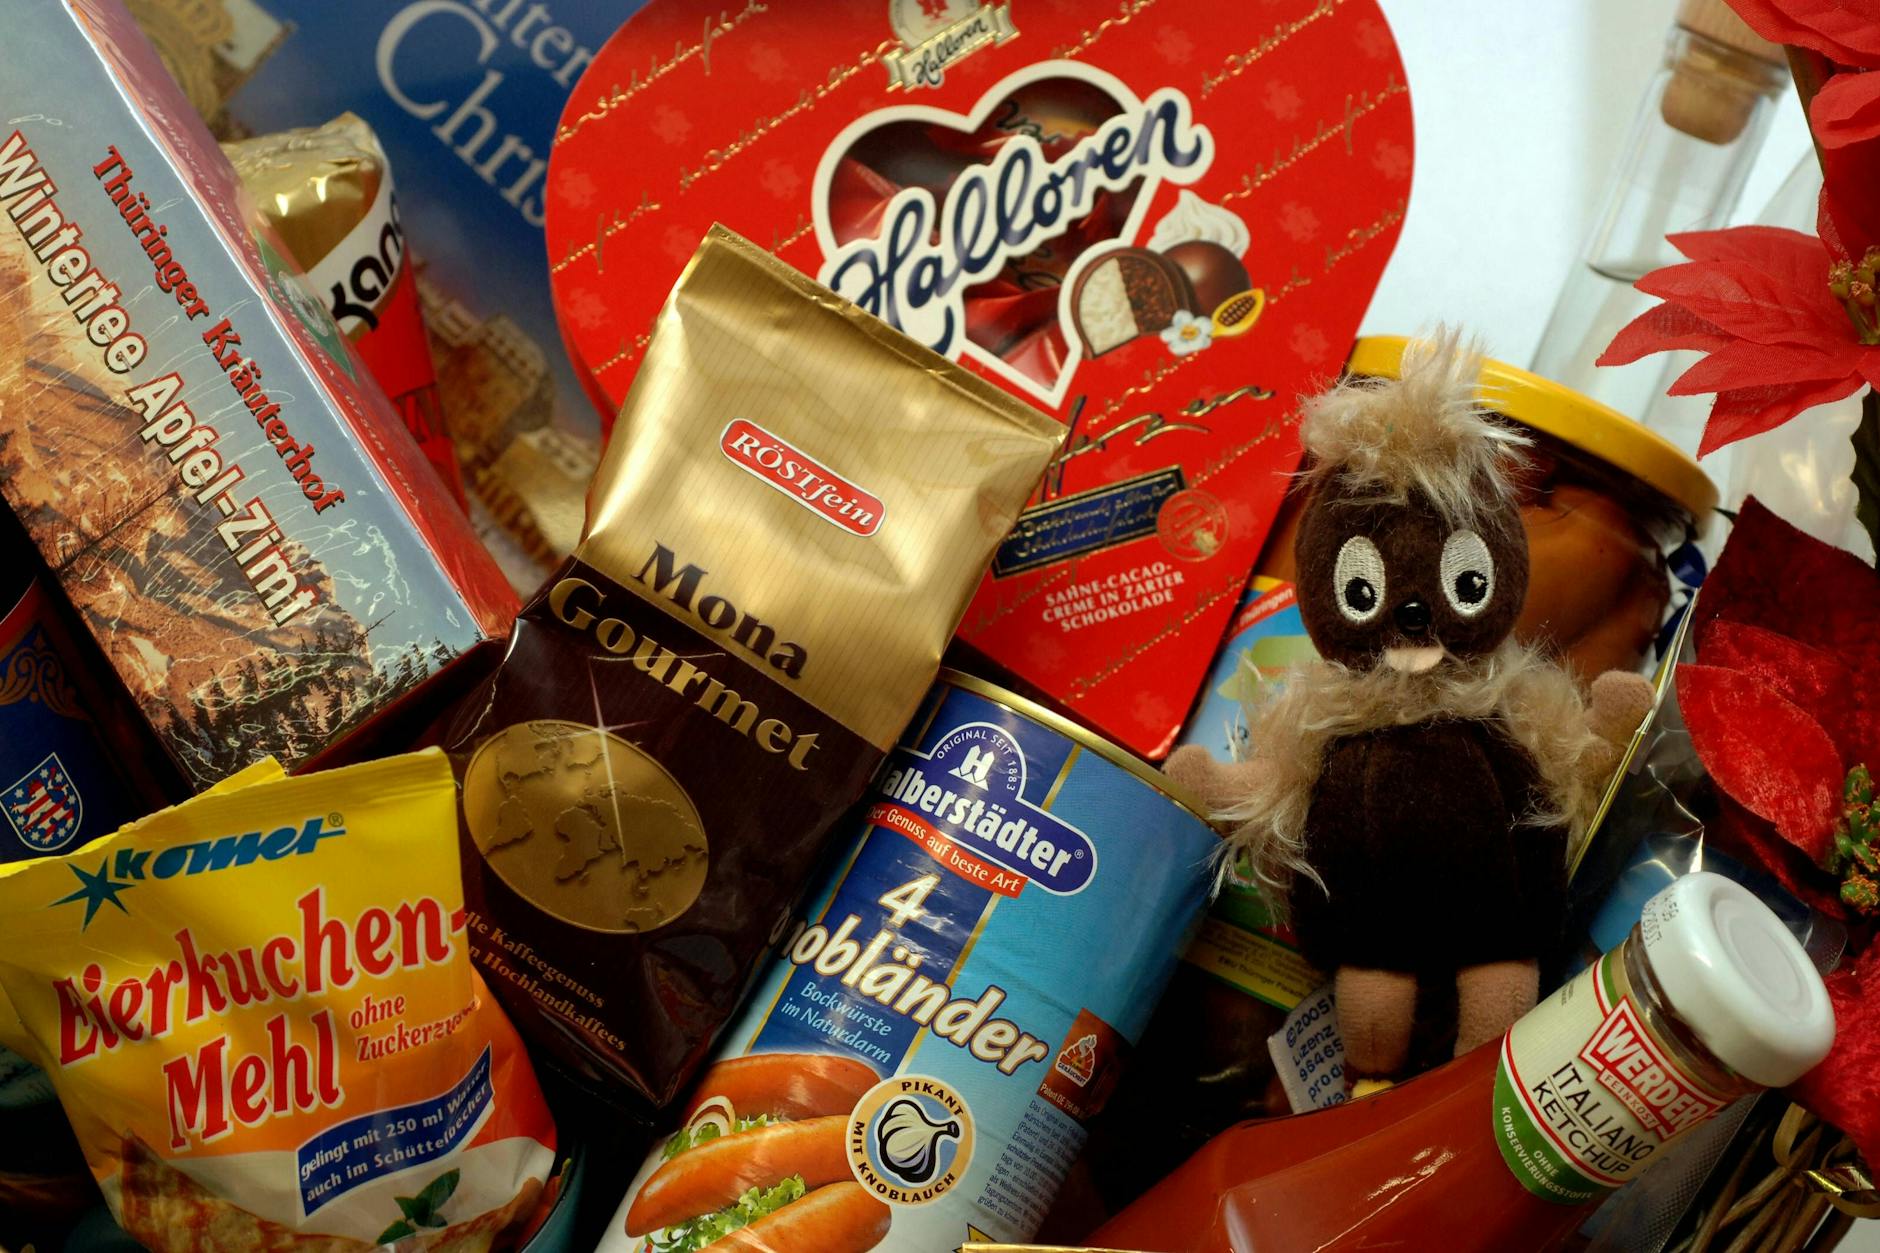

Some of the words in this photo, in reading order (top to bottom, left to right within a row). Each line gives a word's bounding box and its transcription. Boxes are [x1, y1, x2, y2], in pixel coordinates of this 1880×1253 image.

[911, 18, 988, 86] Halloren
[830, 98, 1204, 354] Halloren
[92, 146, 210, 321] Thüringer
[201, 317, 346, 516] Kräuterhof
[0, 130, 148, 375] Wintertee
[124, 371, 319, 627] Apfel-Zimt
[727, 431, 877, 529] RÖSTfein
[632, 541, 809, 681] Mona
[1042, 597, 1097, 623] CREME
[1100, 588, 1121, 606] IN
[1124, 571, 1185, 600] ZARTER
[1060, 588, 1175, 632] SCHOKOLADE
[548, 577, 822, 772] Gourmet
[937, 729, 988, 760] ORIGINAL
[990, 734, 1014, 758] SEIT
[1006, 759, 1018, 792] 1883
[882, 766, 1073, 878] alberstädter
[887, 808, 928, 840] Genuss
[926, 834, 950, 858] auf
[950, 849, 989, 882] beste
[989, 870, 1021, 892] Art
[878, 873, 941, 928] 4
[53, 887, 467, 1067] Eierkuchen-
[480, 951, 628, 1051] Hochlandkaffees
[494, 928, 605, 1009] Kaffeegenuss
[800, 981, 893, 1037] Bockwürste
[781, 996, 801, 1019] im
[801, 1005, 892, 1066] Naturdarm
[1292, 1024, 1336, 1067] Lizenz
[162, 1010, 345, 1152] Mehl
[351, 996, 406, 1029] ohne
[901, 1079, 965, 1117] PIKANT
[1552, 1062, 1656, 1161] ITALIANO
[1597, 1017, 1708, 1128] WERDER
[1603, 1074, 1655, 1127] FEINKOST
[301, 1139, 350, 1182] gelingt
[353, 1126, 381, 1150] mit
[385, 1117, 417, 1138] 250
[422, 1107, 444, 1129] ml
[307, 1173, 342, 1202] auch
[346, 1162, 369, 1179] im
[374, 1083, 488, 1168] Schüttelbecher
[852, 1120, 865, 1157] MIT
[1532, 1080, 1630, 1175] KETCHUP
[1533, 1149, 1560, 1178] OHNE
[856, 1162, 957, 1204] KNOBLAUCH
